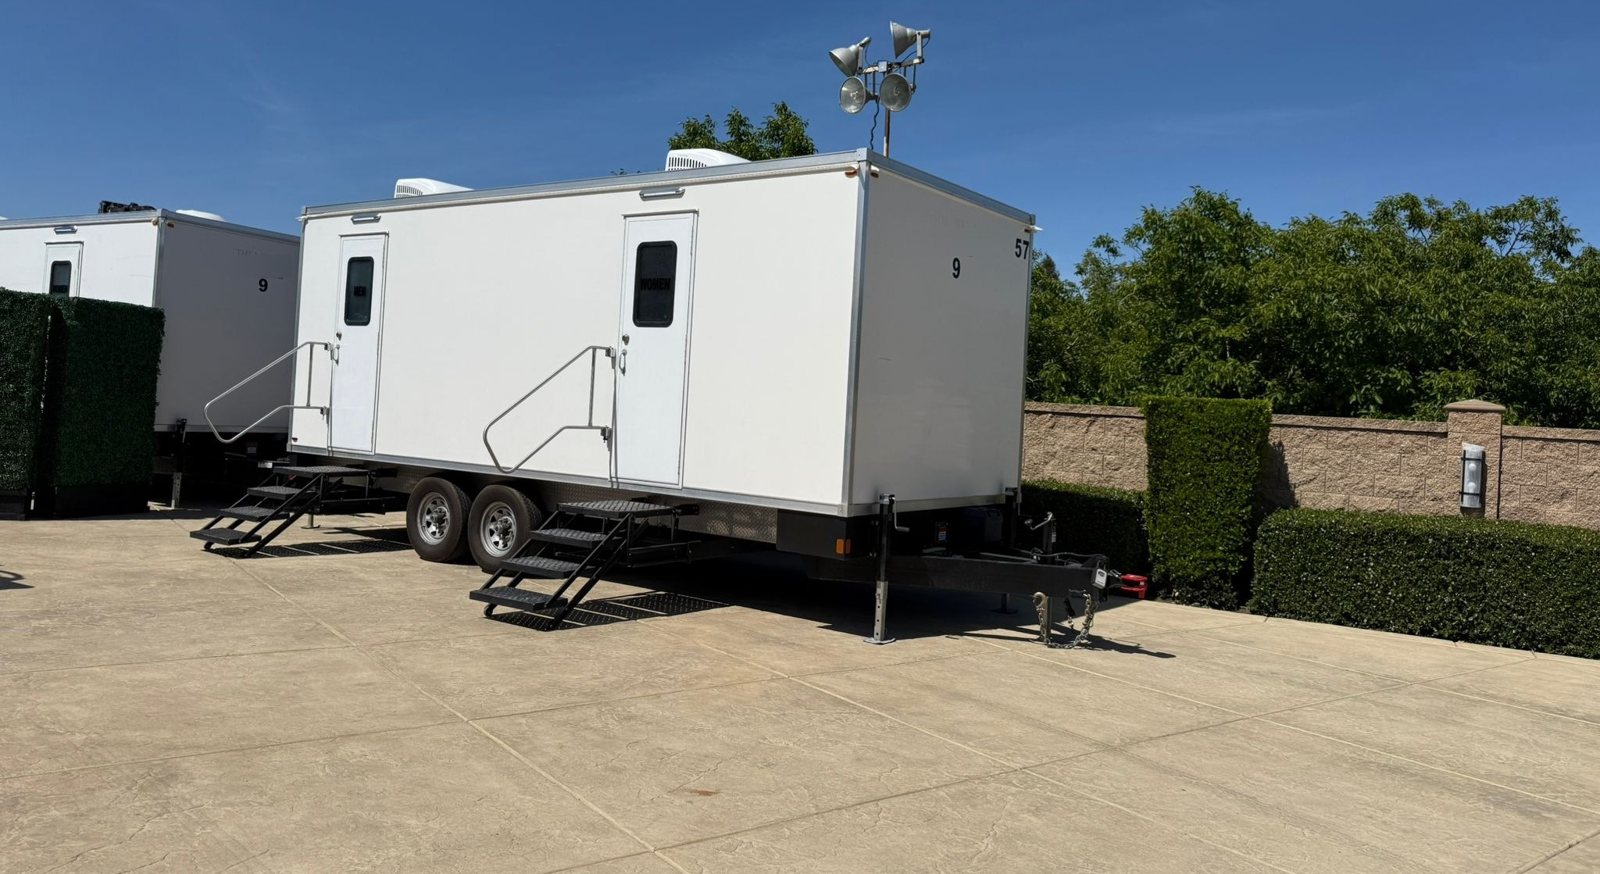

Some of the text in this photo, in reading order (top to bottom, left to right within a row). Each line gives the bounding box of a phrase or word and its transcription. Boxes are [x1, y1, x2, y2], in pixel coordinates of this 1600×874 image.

[1015, 238, 1029, 260] 57
[952, 257, 961, 279] 9
[258, 278, 269, 293] 9
[640, 277, 671, 291] WOMEN
